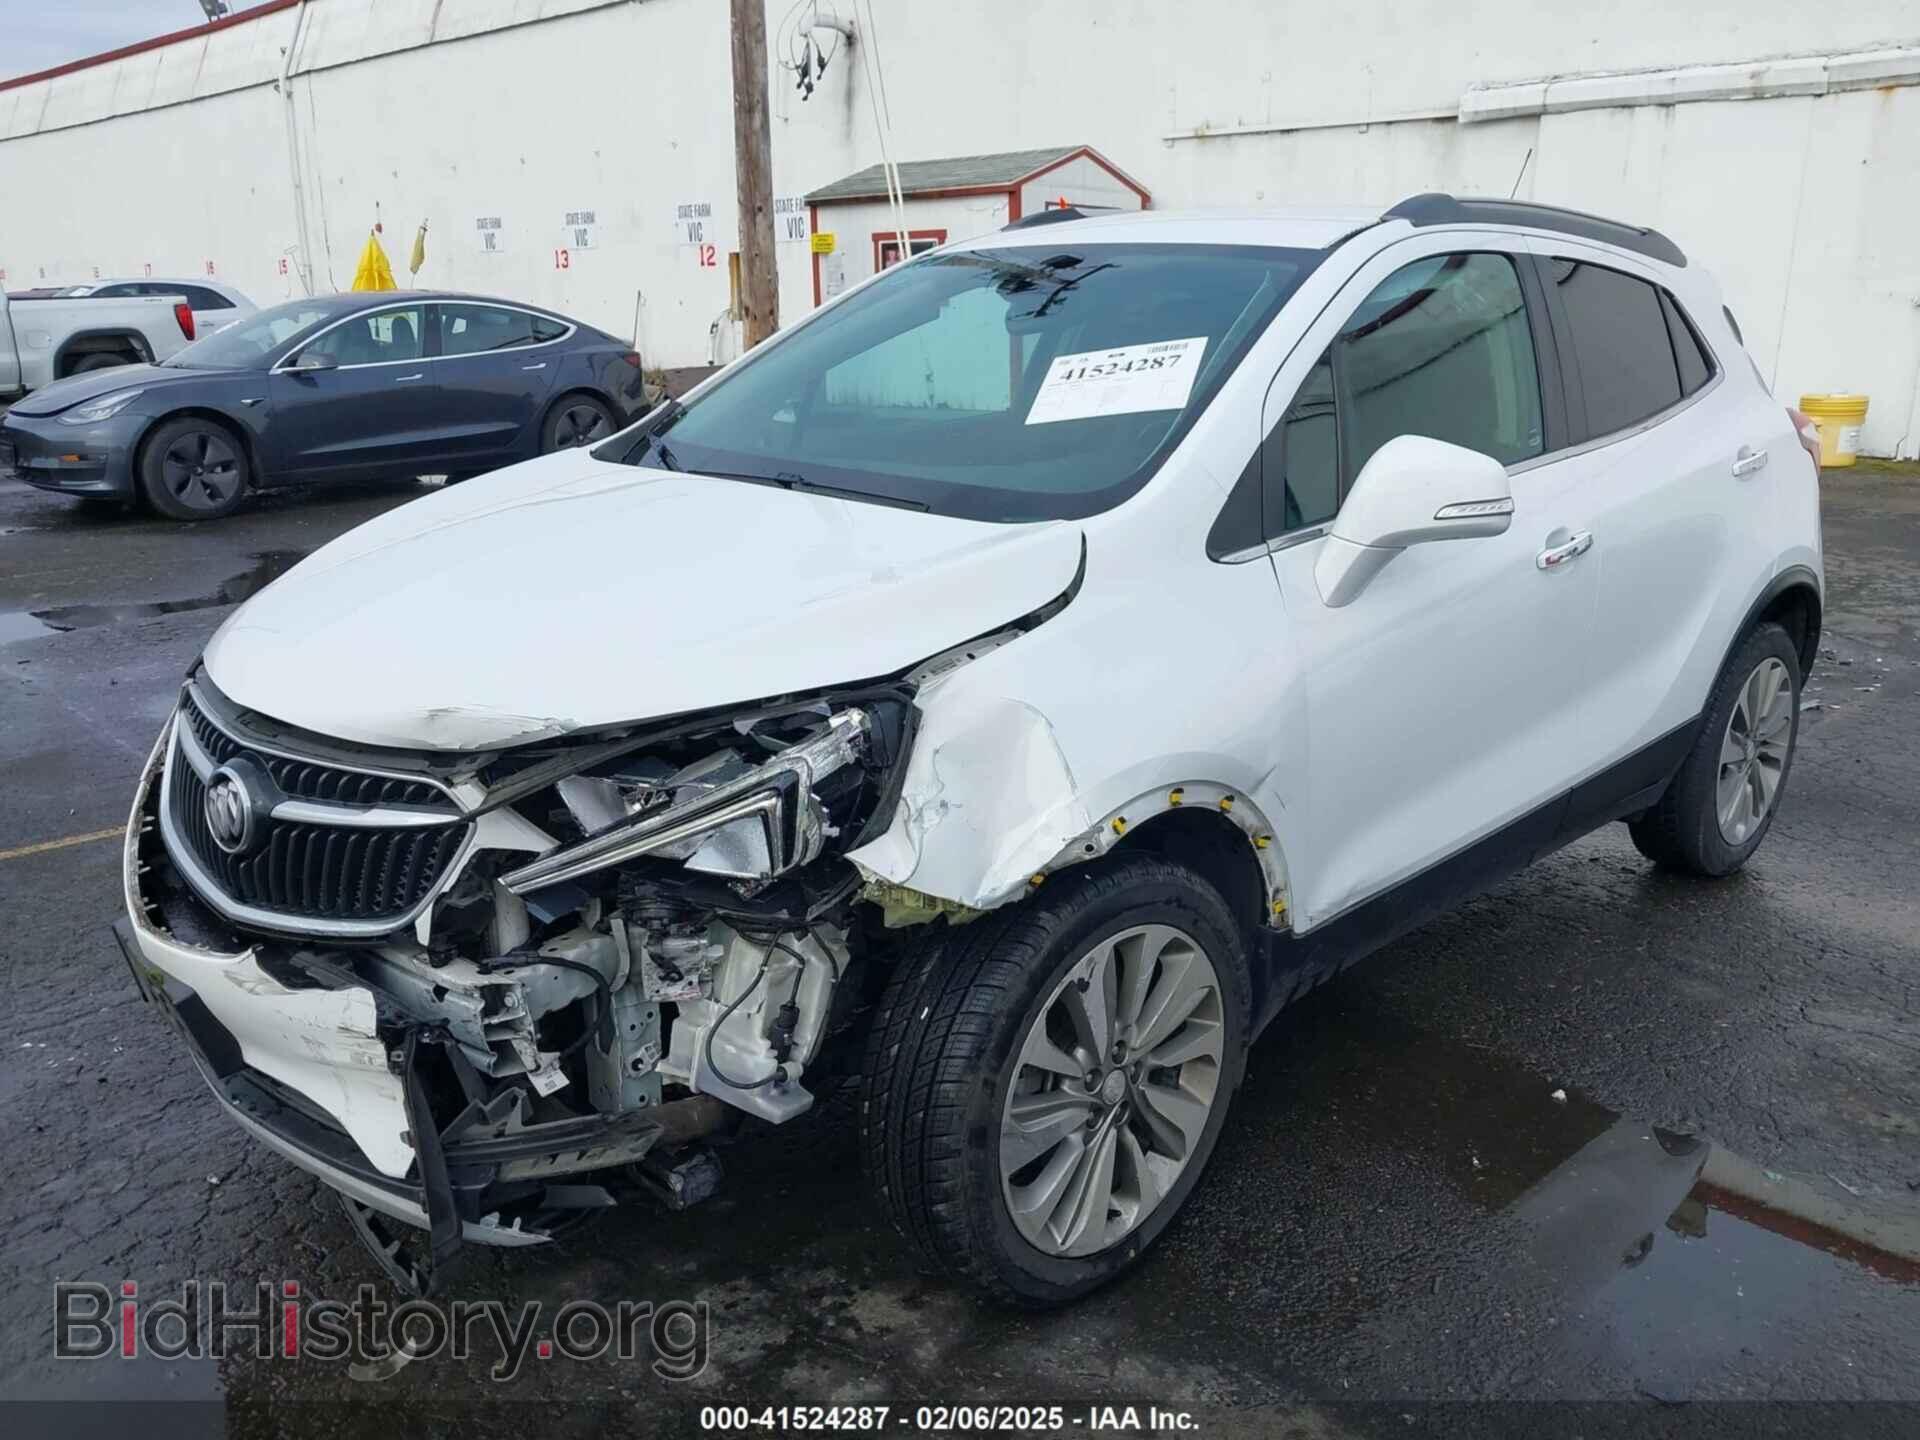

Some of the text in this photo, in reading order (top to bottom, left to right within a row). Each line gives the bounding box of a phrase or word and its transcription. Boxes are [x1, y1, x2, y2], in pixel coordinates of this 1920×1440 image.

[678, 203, 711, 219] STATE FARM
[775, 199, 795, 214] STATE
[566, 212, 580, 226] STATE
[787, 217, 805, 239] VIC
[484, 232, 496, 250] VIC
[574, 228, 589, 247] VIC
[688, 222, 703, 242] VIC
[555, 249, 569, 269] 13
[700, 246, 716, 266] 12
[1058, 355, 1182, 381] 41524287
